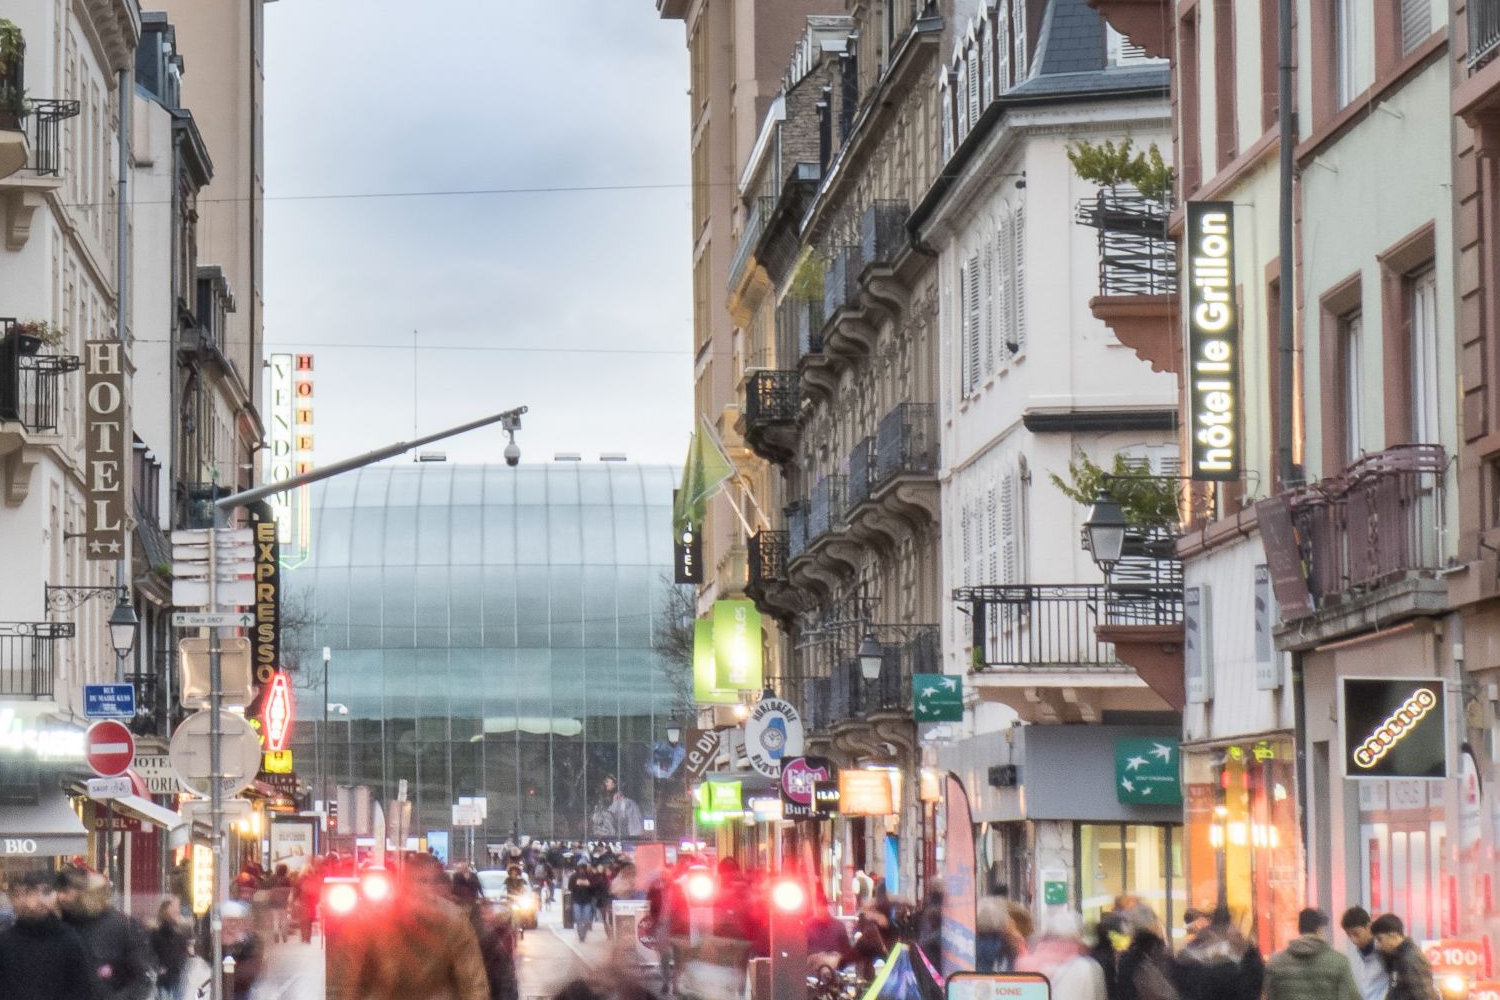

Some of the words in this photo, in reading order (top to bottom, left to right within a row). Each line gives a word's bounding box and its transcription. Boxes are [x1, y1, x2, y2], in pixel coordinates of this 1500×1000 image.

[1195, 213, 1228, 331] Grillon
[1198, 340, 1231, 371] le
[87, 343, 121, 531] HOTEL
[1199, 380, 1232, 471] hôtel
[257, 522, 275, 684] EXPRESSO
[753, 701, 797, 722] HORLOGERIE
[1356, 691, 1434, 765] FEELING
[146, 777, 180, 791] TORIA
[752, 754, 780, 776] BIJOUT
[4, 839, 37, 854] BIO
